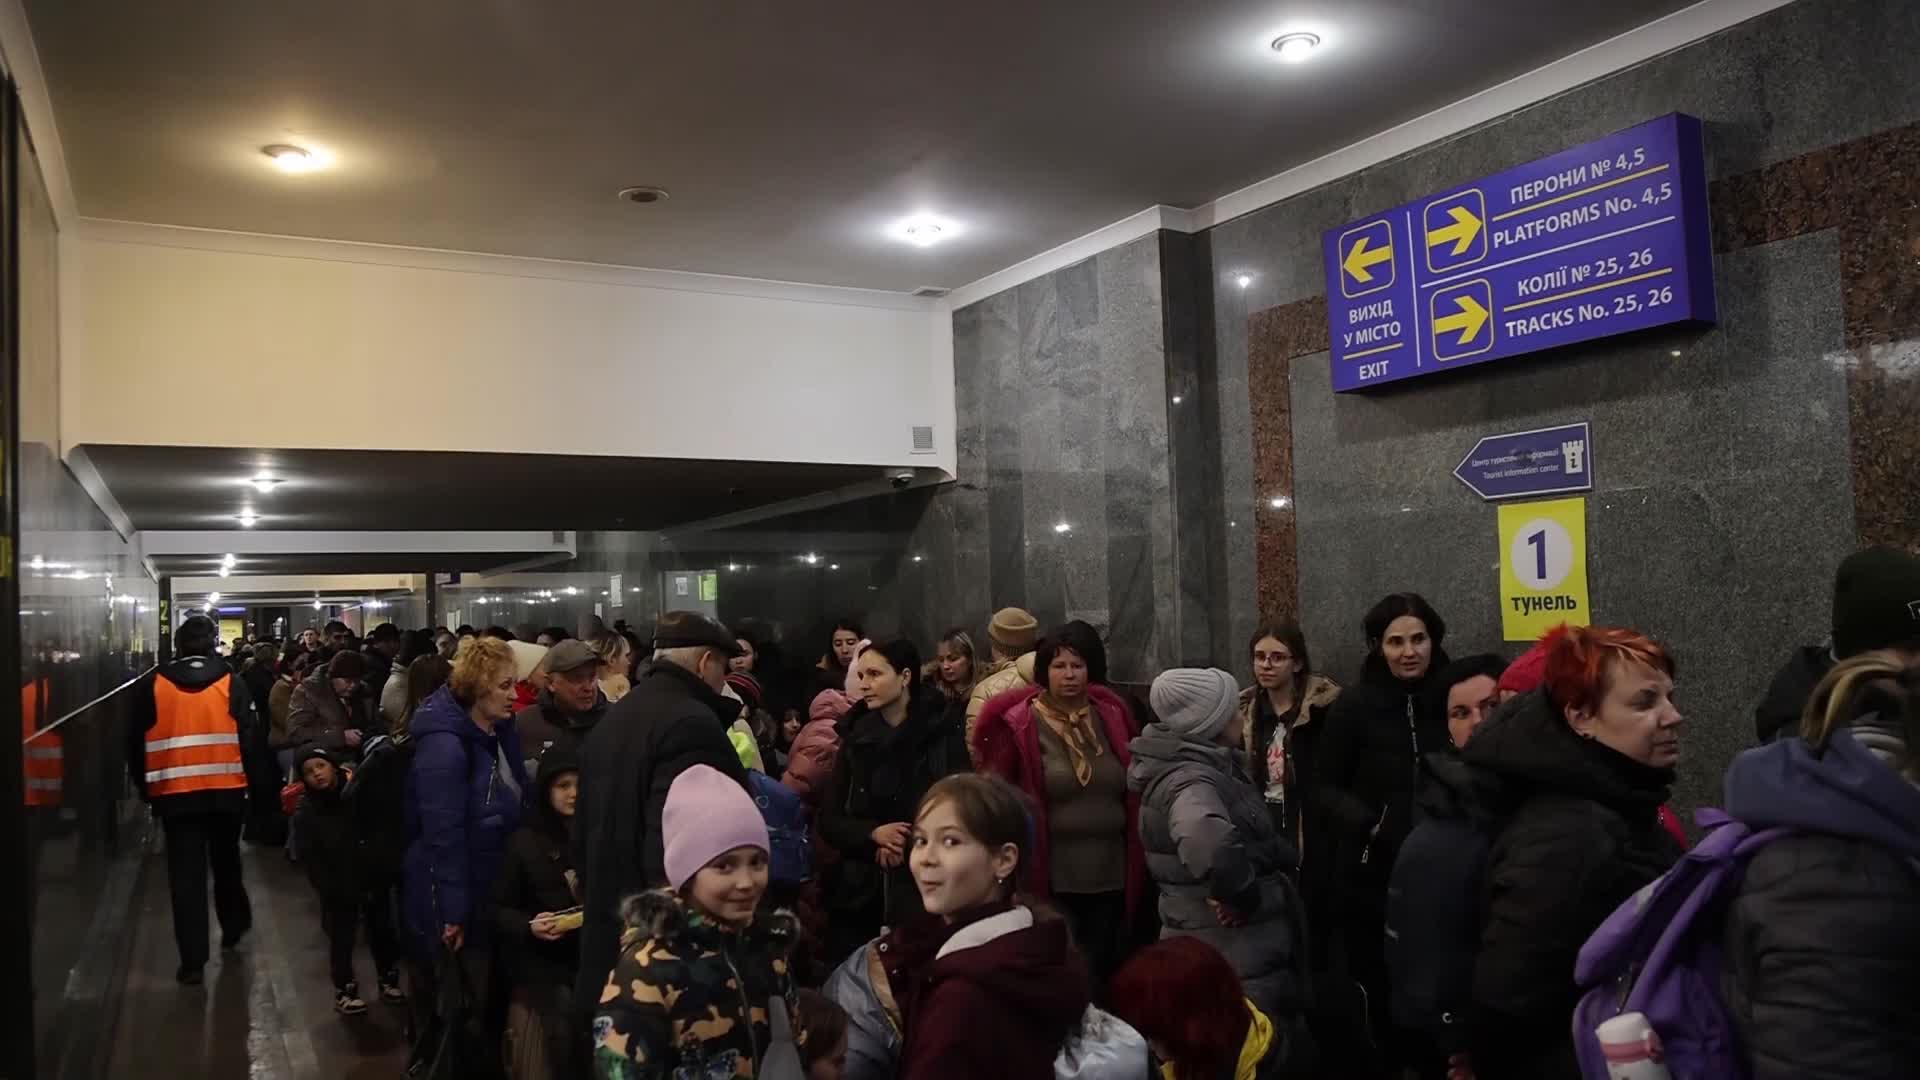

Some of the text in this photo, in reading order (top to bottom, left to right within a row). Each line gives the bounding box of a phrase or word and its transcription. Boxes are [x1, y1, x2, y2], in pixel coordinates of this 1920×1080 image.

[1510, 168, 1586, 204] ПЕРОНИ
[1615, 147, 1646, 173] 4,5
[1493, 182, 1673, 248] PLATFORMS No. 4,5
[1517, 266, 1567, 297] КОЛІЇ
[1595, 256, 1625, 280] 25,
[1629, 248, 1653, 268] 26
[1348, 299, 1393, 325] ВИХІД
[1505, 286, 1673, 338] TRACKS No. 25, 26
[1343, 321, 1401, 349] У МІСТО
[1358, 360, 1390, 381] EXIT
[1483, 470, 1504, 480] Tourist
[1504, 465, 1539, 477] information
[1528, 529, 1547, 580] 1
[1511, 593, 1577, 616] тунель
